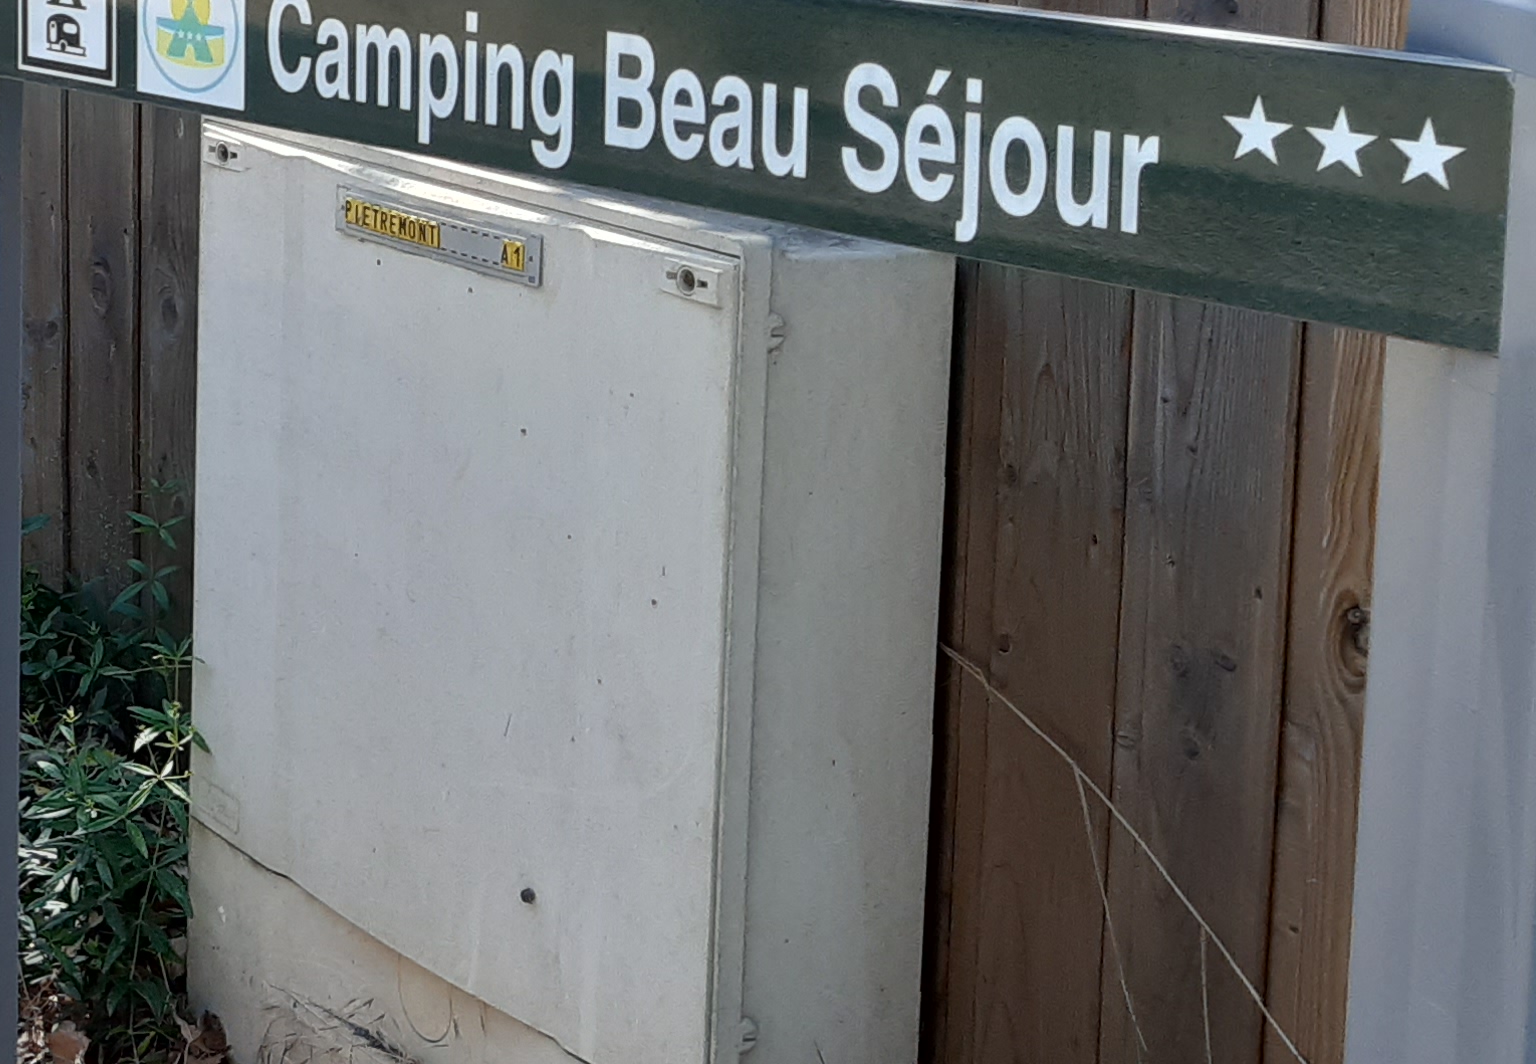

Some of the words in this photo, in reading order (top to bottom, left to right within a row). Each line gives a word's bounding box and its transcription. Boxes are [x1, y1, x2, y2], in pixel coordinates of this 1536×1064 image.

[603, 29, 810, 180] Beau
[840, 61, 1161, 244] Séjour
[345, 199, 438, 247] PIETREMONT
[500, 243, 524, 269] A1
